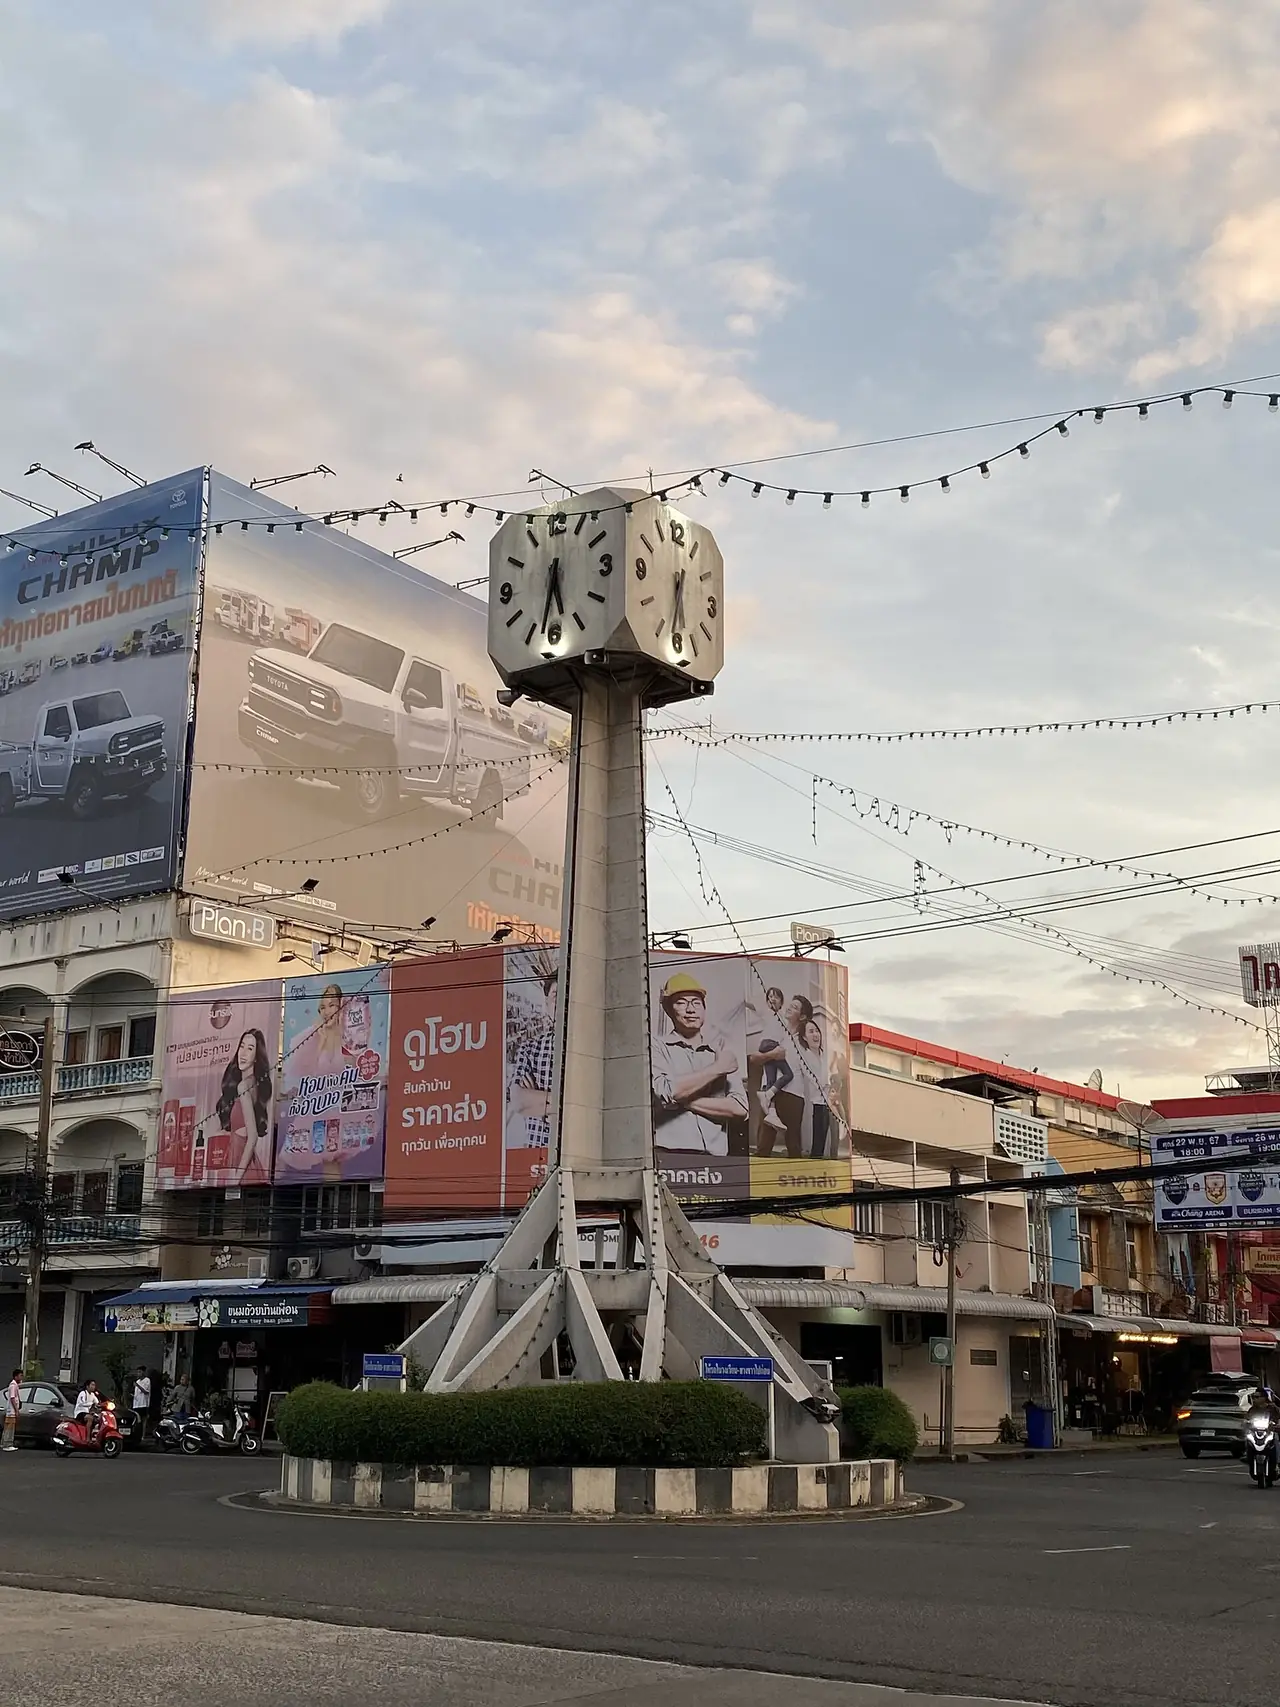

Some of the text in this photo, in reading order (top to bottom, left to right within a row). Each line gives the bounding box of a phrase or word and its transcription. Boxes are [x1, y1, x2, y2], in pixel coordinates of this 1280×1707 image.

[669, 519, 685, 547] 12
[17, 539, 160, 605] CHAMP
[599, 553, 613, 577] 3
[635, 557, 647, 581] 9
[499, 582, 513, 605] 9
[707, 596, 717, 619] 3
[547, 623, 562, 645] 6
[671, 632, 683, 654] 6
[266, 675, 289, 691] TOYOTA
[256, 729, 279, 744] CHAMP
[201, 906, 265, 942] Plan B
[403, 1016, 487, 1072] ดูโฮม
[403, 1078, 451, 1095] สินค้าบ้าน
[401, 1093, 487, 1128] ราคาส่ง
[401, 1131, 487, 1156] ทุกวัน เพื่อทุกคน
[1176, 1138, 1186, 1147] 22
[1209, 1135, 1220, 1145] 67
[1255, 1133, 1266, 1142] 26
[1180, 1147, 1205, 1156] 18:00
[659, 1165, 723, 1186] ราคาส่ง
[778, 1170, 838, 1189] ราคาส่ง
[1181, 1208, 1225, 1219] Chang ARENA
[227, 1299, 299, 1317] ขนมถ้วยบ้านเพื่อน
